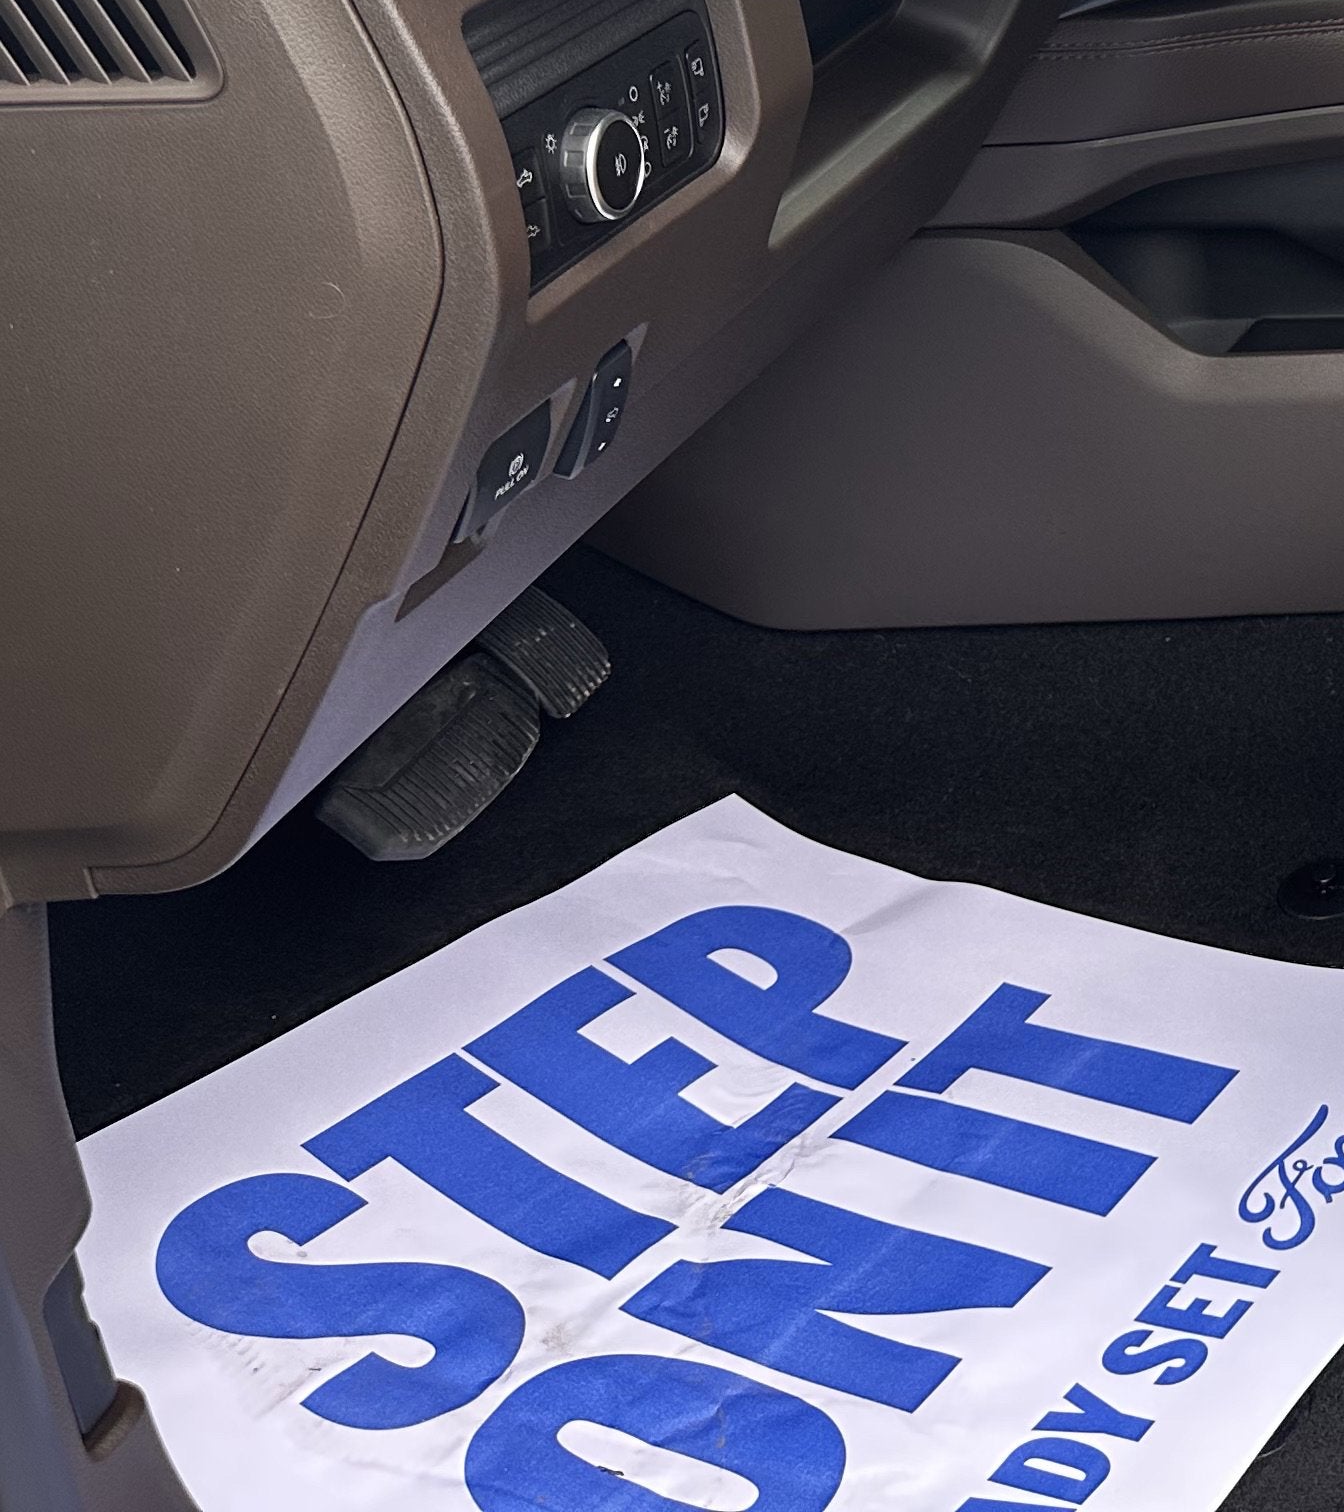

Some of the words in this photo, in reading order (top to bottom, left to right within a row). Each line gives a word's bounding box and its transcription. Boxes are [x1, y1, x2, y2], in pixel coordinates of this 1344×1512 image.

[153, 904, 908, 1431] STEP
[463, 1185, 1051, 1512] ON
[830, 982, 1240, 1217] IT
[1101, 1242, 1281, 1385] SET
